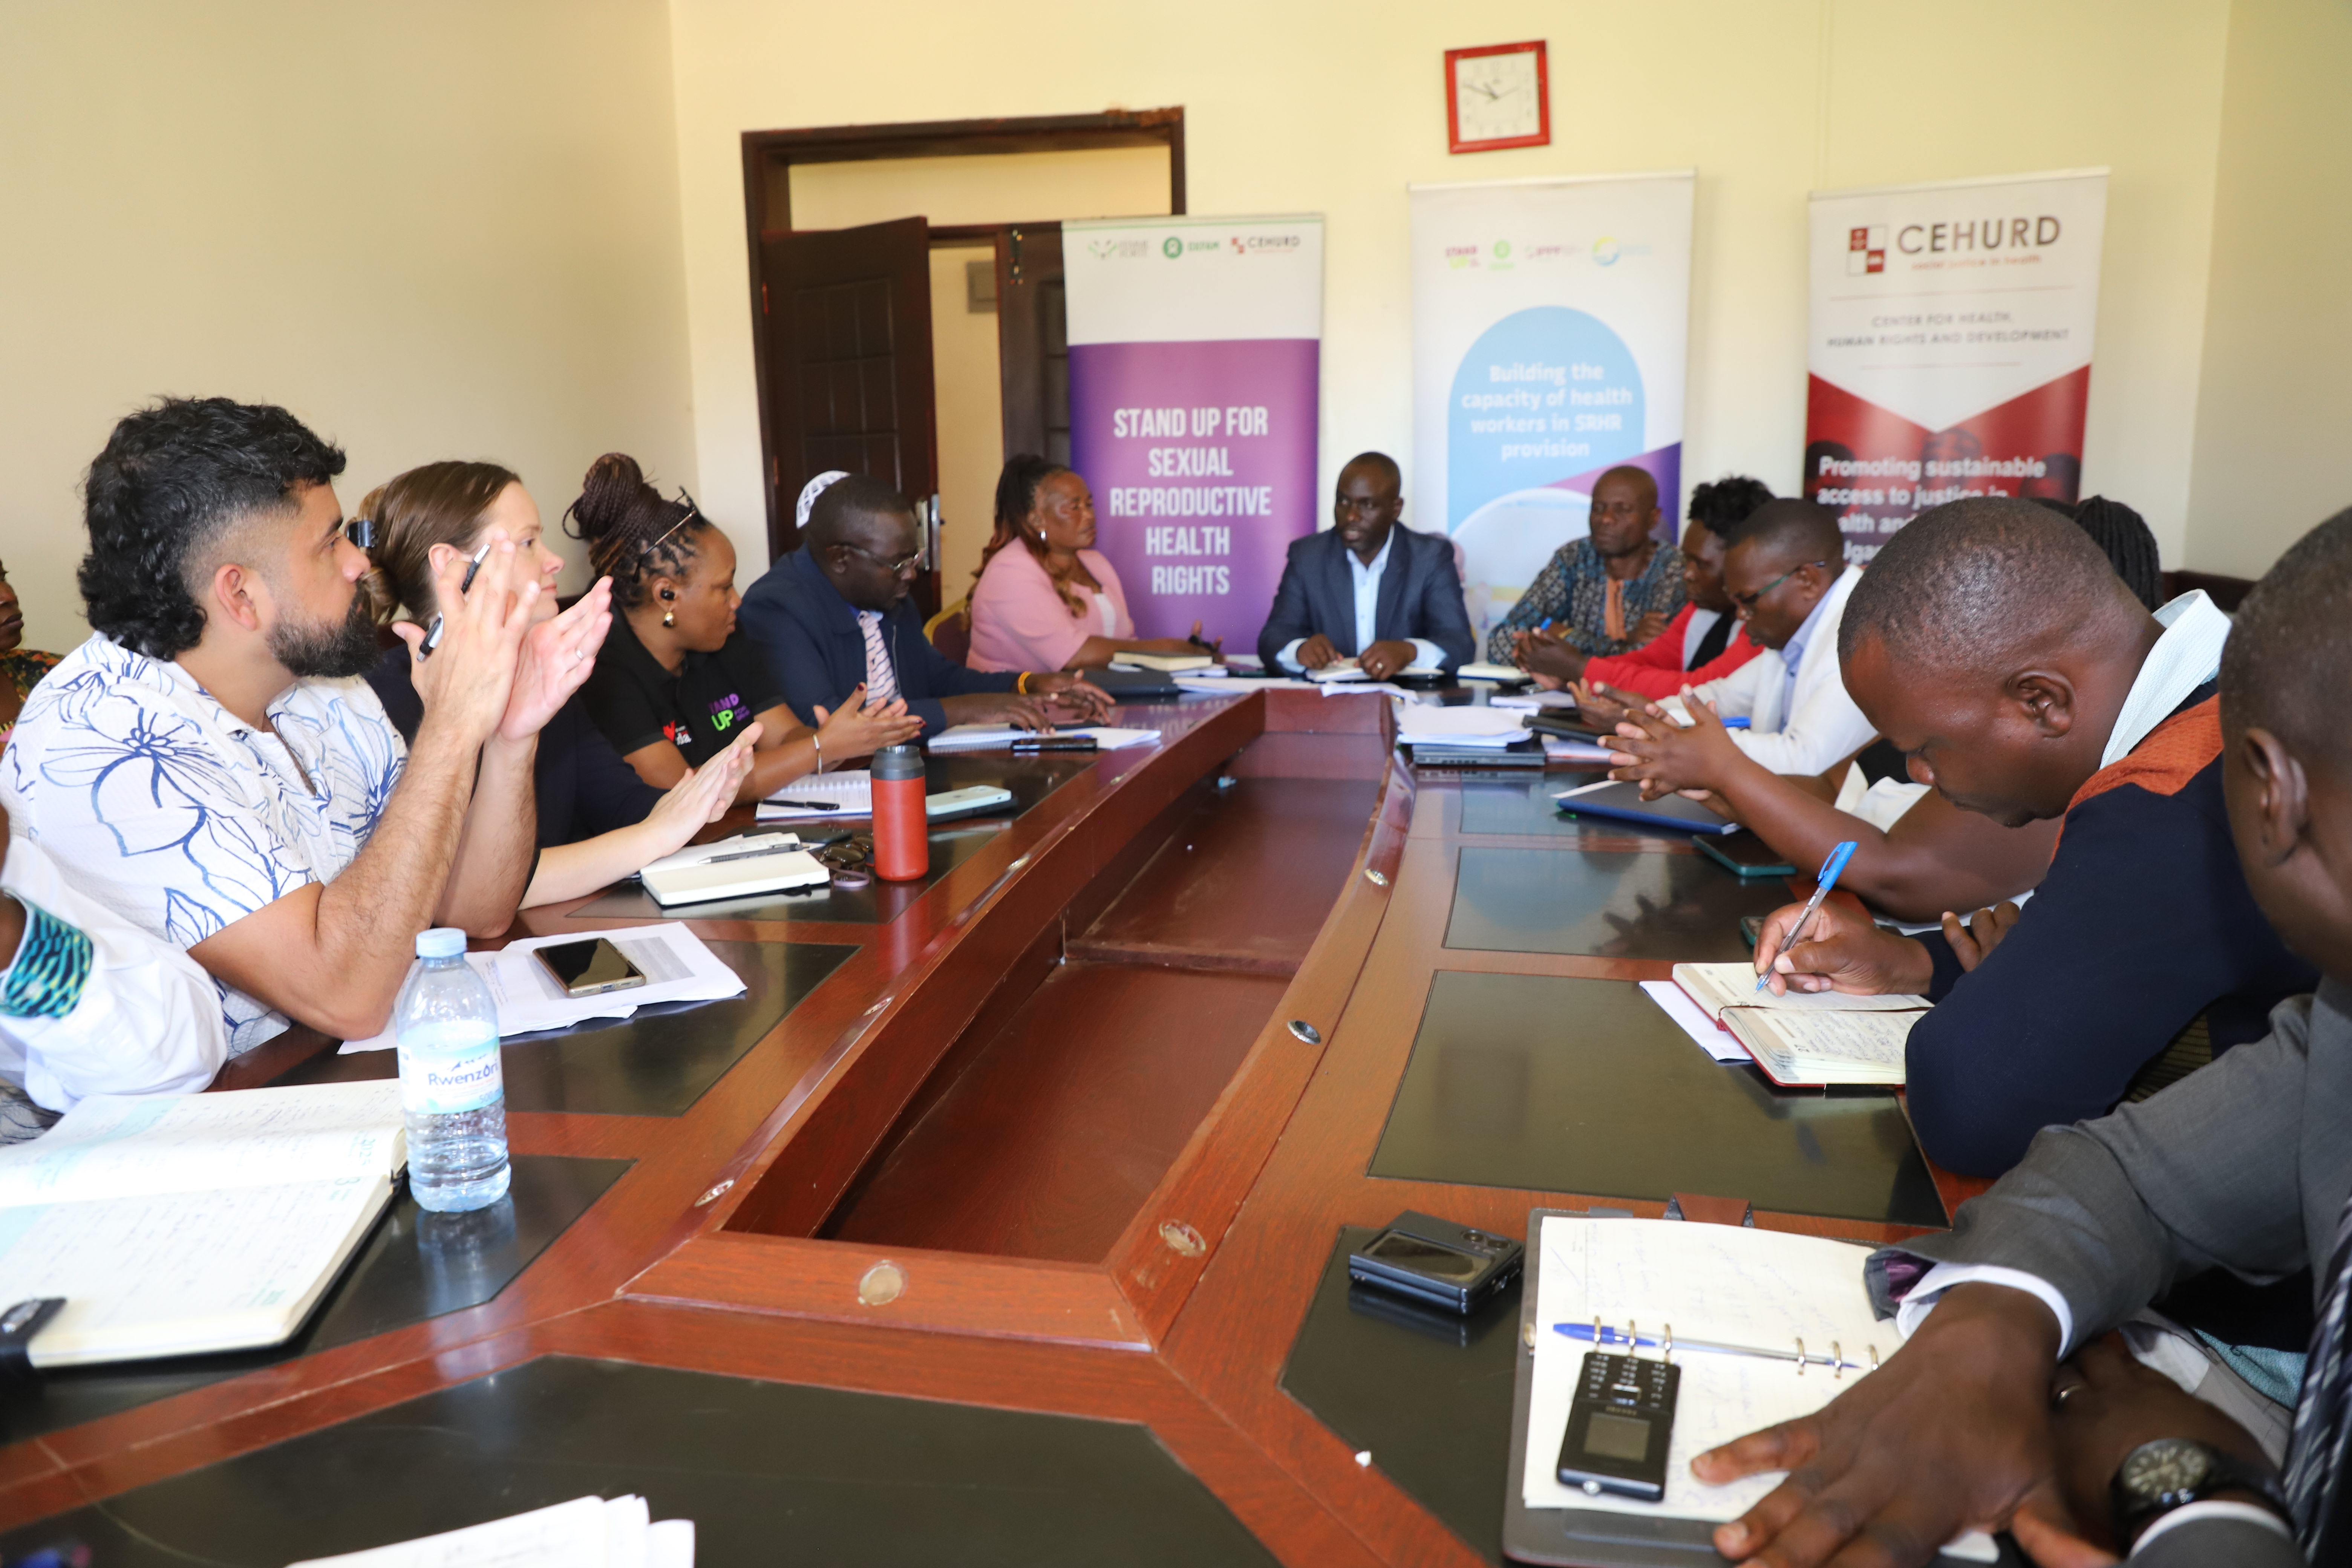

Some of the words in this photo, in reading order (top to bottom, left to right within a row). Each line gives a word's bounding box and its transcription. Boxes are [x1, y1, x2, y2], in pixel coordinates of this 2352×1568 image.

[1898, 216, 2061, 254] CEHURD
[1871, 314, 1922, 328] CENTER
[1926, 312, 1953, 325] FOR
[1827, 336, 1874, 347] HUMAN
[1879, 332, 1926, 346] RIGHTS
[1930, 331, 1962, 343] AND
[1966, 329, 2069, 343] DEVELOPMENT
[1490, 362, 1566, 386] Building
[1571, 363, 1604, 380] the
[1461, 389, 1541, 411] capacity
[1547, 389, 1566, 406] of
[1570, 387, 1633, 406] health
[1113, 408, 1187, 438] STAND
[1191, 407, 1221, 437] UP
[1226, 406, 1269, 436] FOR
[1471, 415, 1545, 433] workers
[1552, 413, 1570, 431] in
[1574, 413, 1622, 431] SRHR
[1148, 447, 1234, 477] SEXUAL
[1501, 438, 1590, 462] provision
[1819, 455, 1922, 481] Promoting
[1925, 456, 2046, 478] sustainable
[1110, 486, 1272, 516] REPRODUCTIVE
[1817, 489, 1884, 505] access
[1889, 487, 1910, 505] to
[1145, 526, 1230, 555] HEALTH
[1152, 565, 1230, 595] RIGHTS
[711, 709, 734, 731] UP
